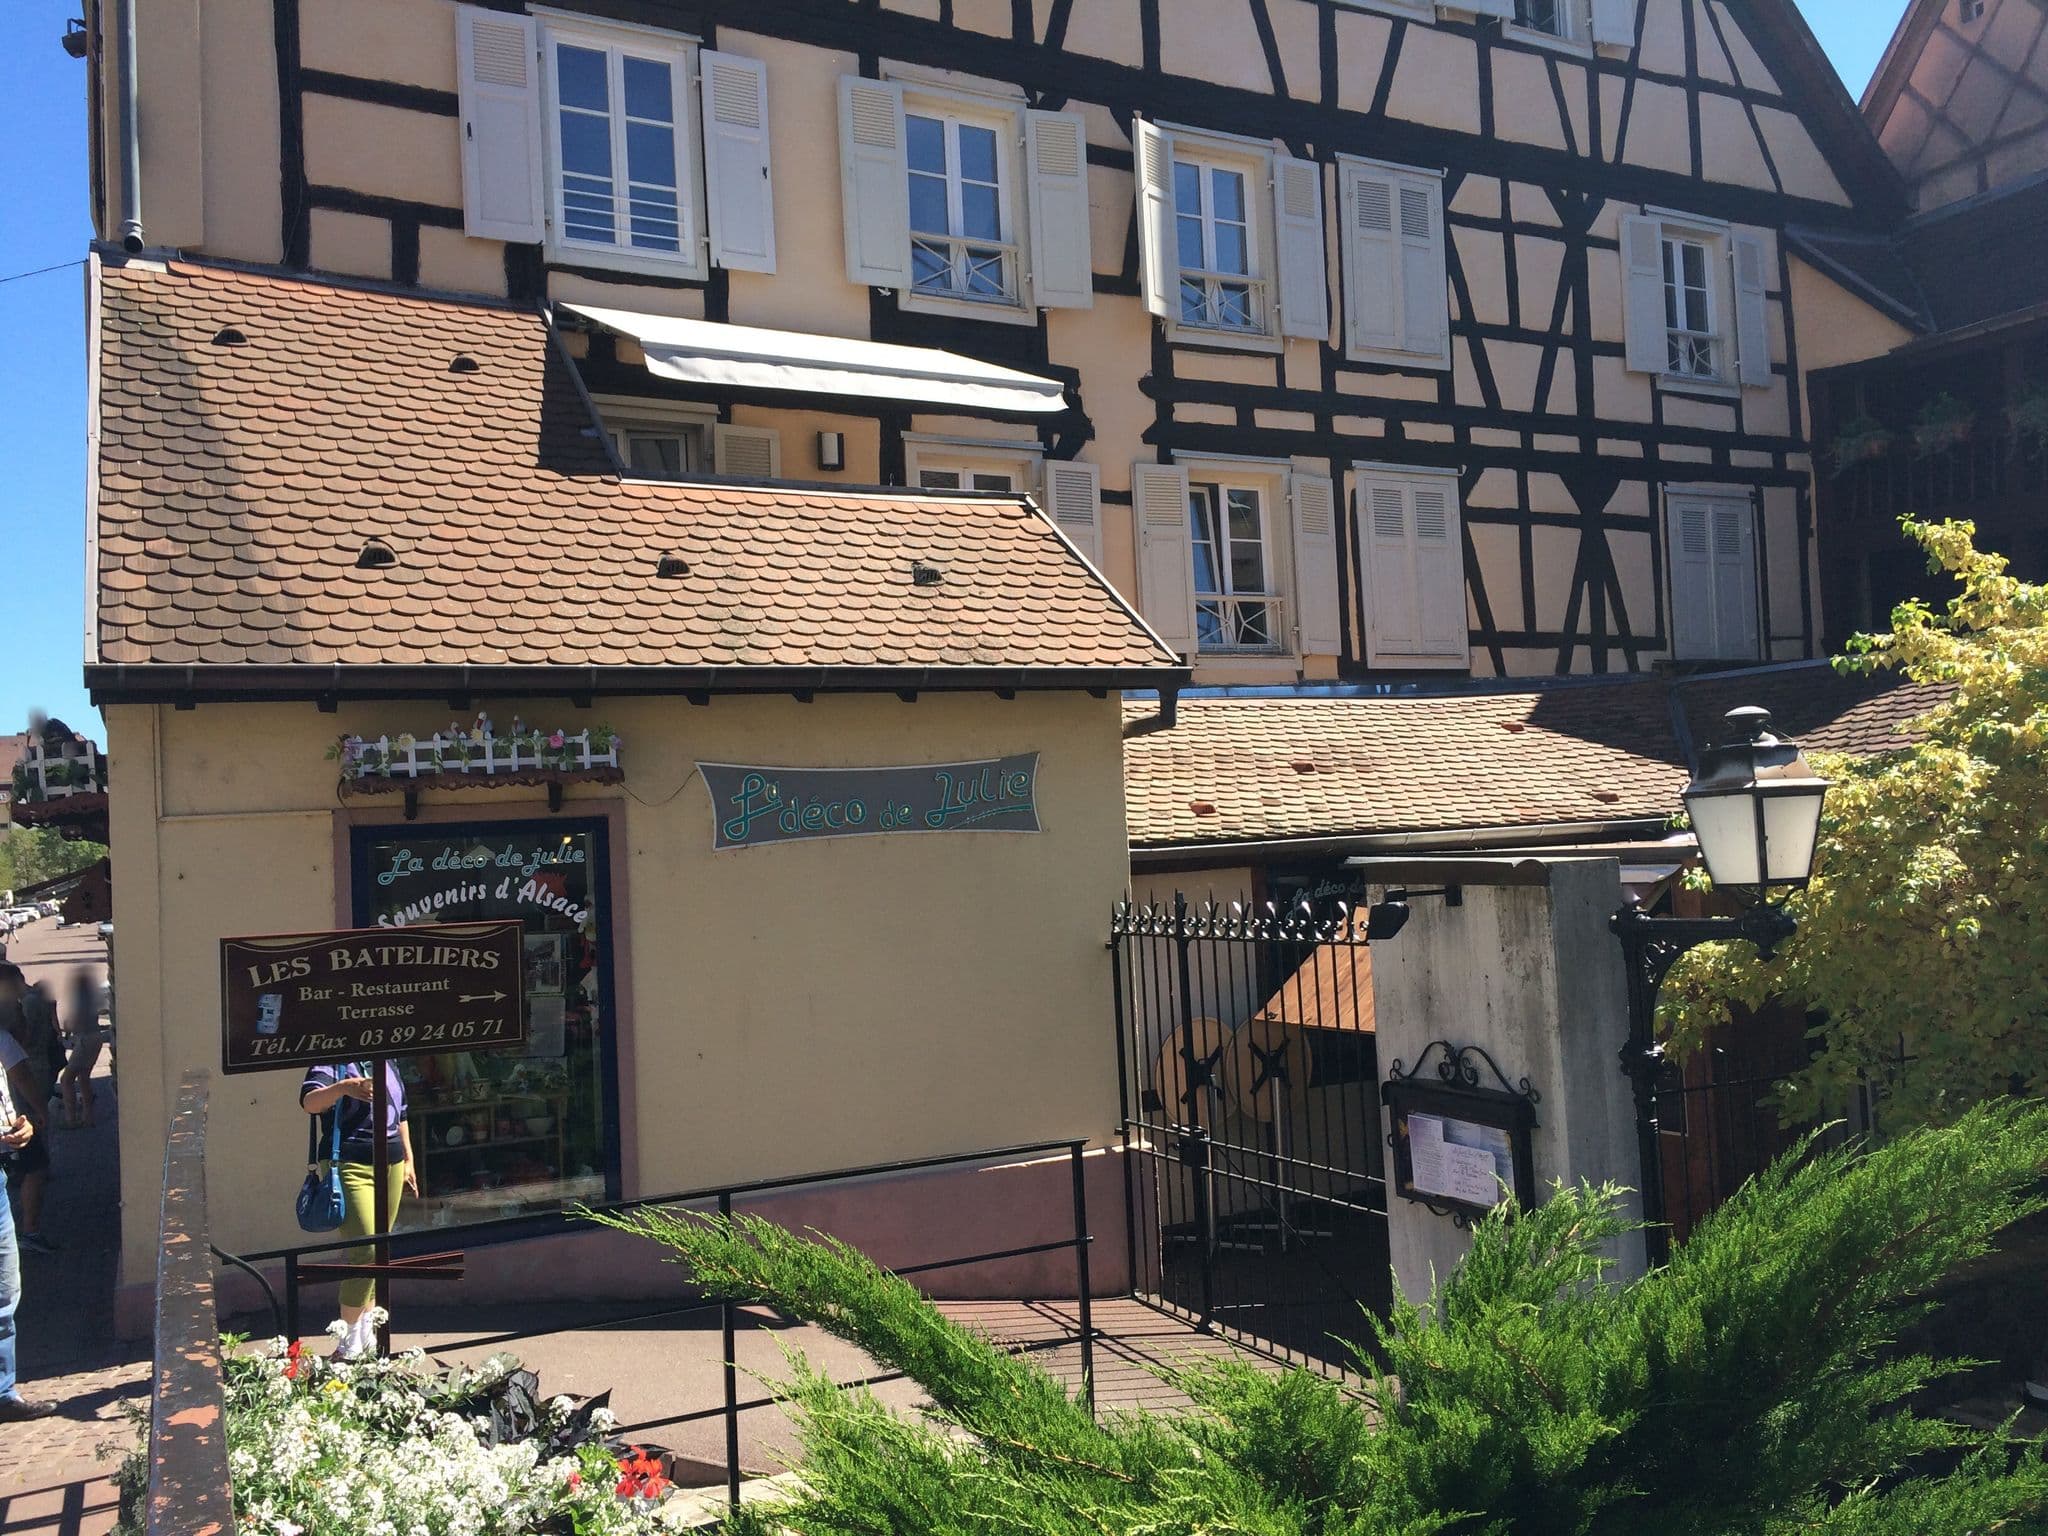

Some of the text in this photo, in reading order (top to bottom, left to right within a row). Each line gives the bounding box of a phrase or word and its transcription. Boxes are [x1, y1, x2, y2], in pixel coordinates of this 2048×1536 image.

[723, 768, 1029, 841] La déco de Julie
[377, 842, 585, 885] La déco de julie
[377, 876, 588, 928] Souvenirs d'Alsace
[248, 945, 501, 988] LES BATELIERS
[298, 986, 333, 1002] Bar
[351, 977, 451, 998] Restaurant
[337, 1003, 415, 1021] Terrasse
[359, 1029, 384, 1046] 03
[390, 1026, 416, 1044] 89
[420, 1023, 445, 1040] 24
[451, 1020, 475, 1038] 05
[481, 1018, 504, 1036] 71
